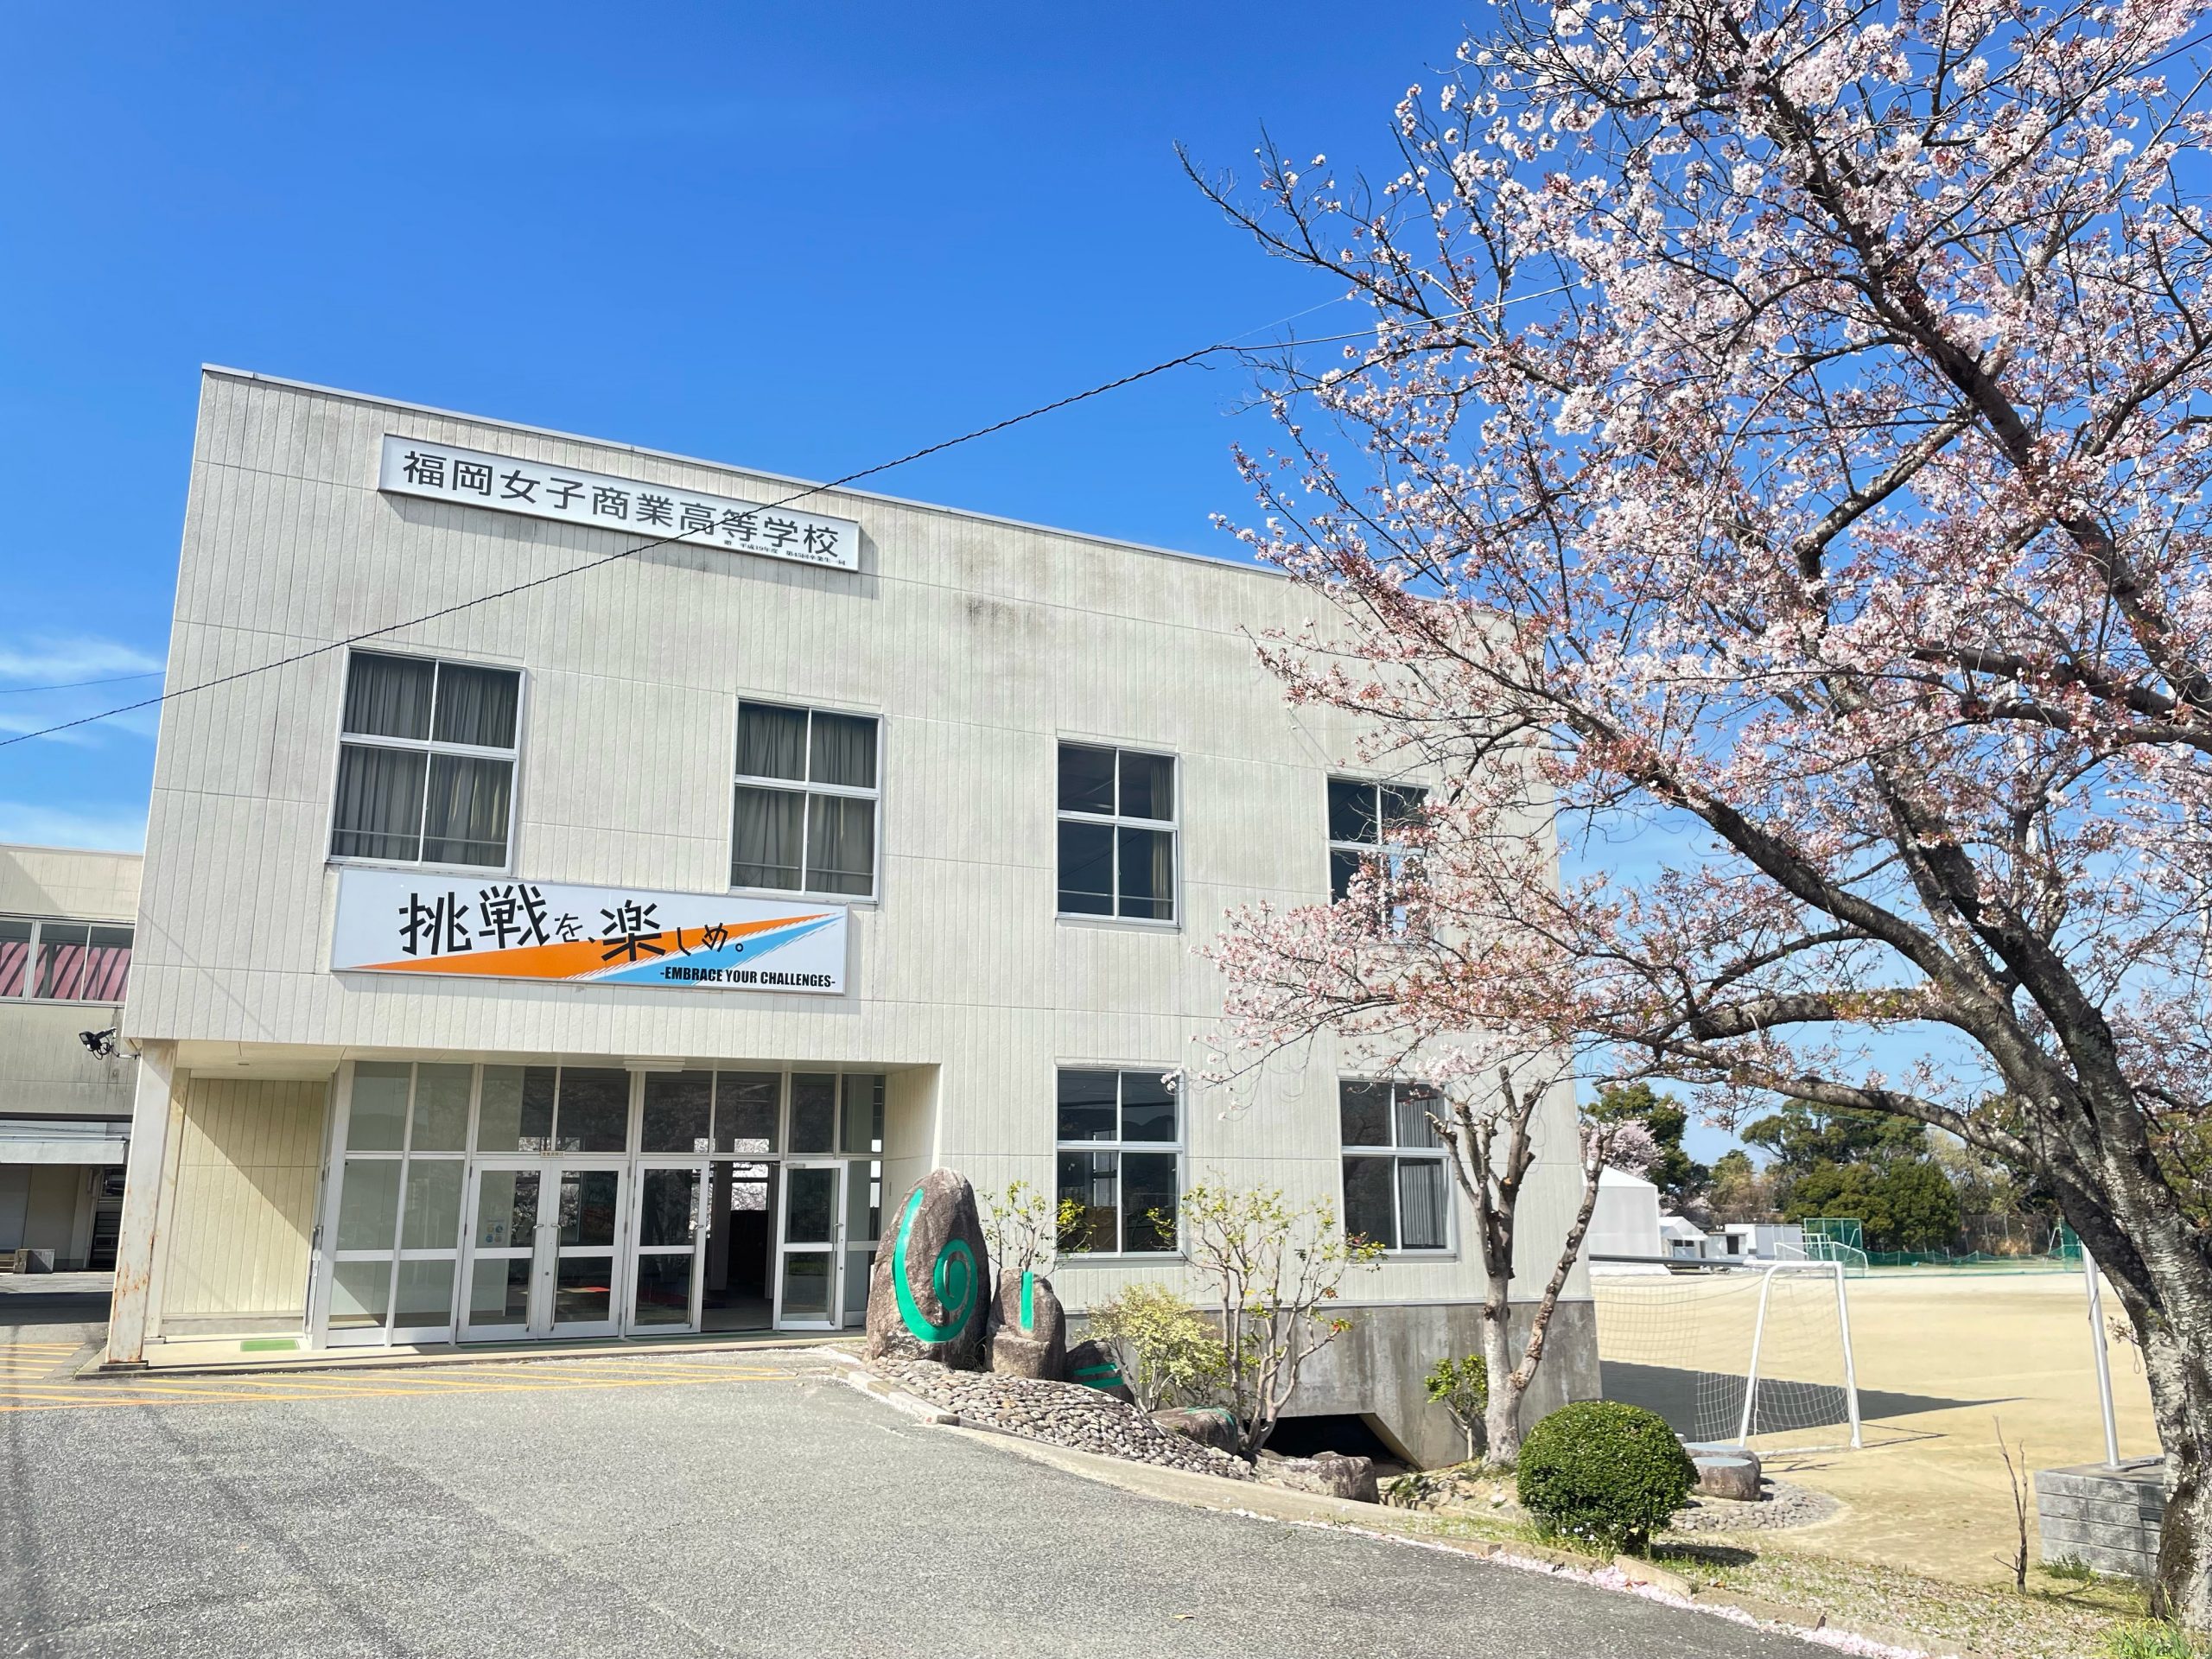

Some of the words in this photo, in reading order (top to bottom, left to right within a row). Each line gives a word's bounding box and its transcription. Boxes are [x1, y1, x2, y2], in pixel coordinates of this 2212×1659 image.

[402, 449, 840, 558] 福岡女子商業高等学校
[397, 882, 745, 962] 挑戦を、楽しめ。
[659, 966, 723, 982] -EMBRACE
[726, 969, 757, 984] YOUR
[760, 971, 836, 988] CHALLENGES-
